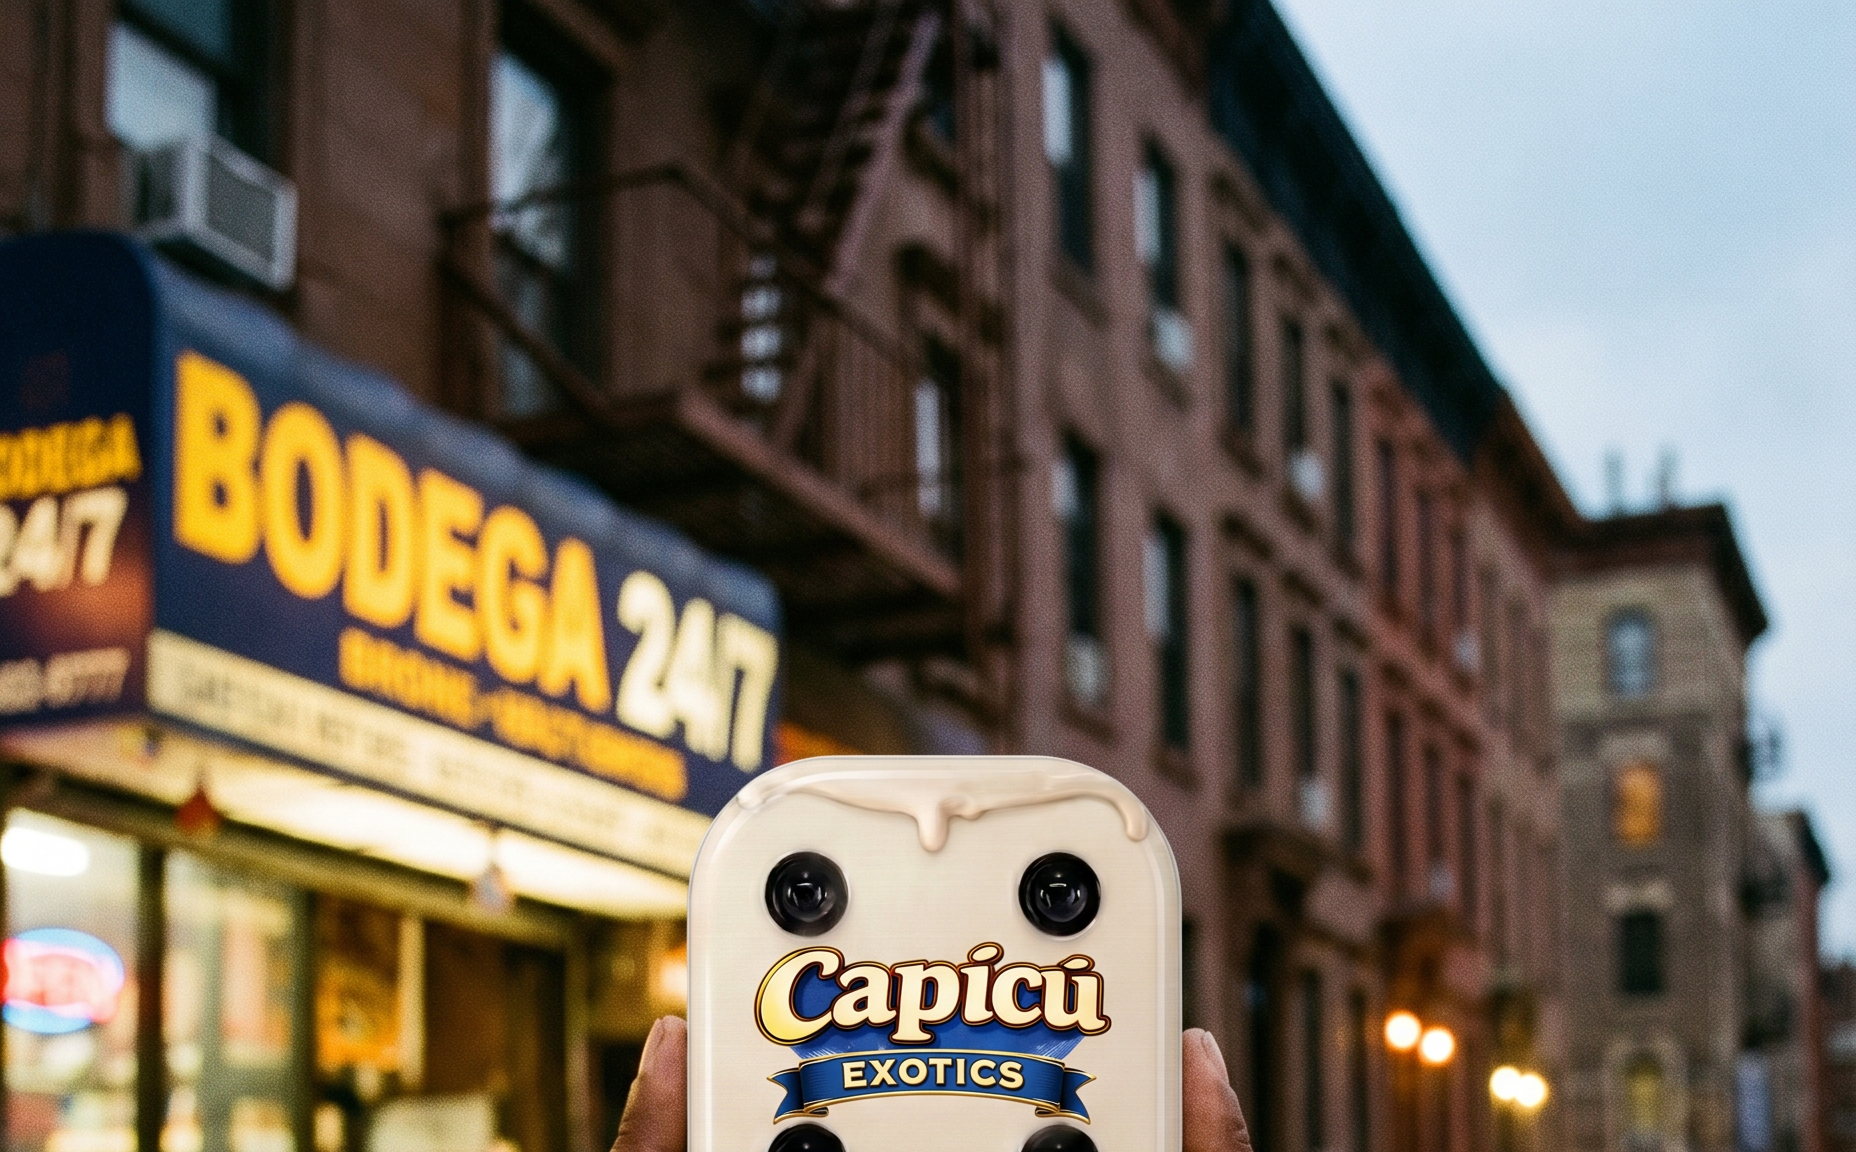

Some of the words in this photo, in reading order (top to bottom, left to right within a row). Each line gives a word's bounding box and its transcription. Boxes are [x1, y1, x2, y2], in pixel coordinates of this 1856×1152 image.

[0, 411, 143, 498] ODEGA
[172, 348, 611, 713] BODEGA
[616, 569, 779, 773] 24/7
[755, 942, 1111, 1044] Capicú
[842, 1057, 1025, 1089] EXOTICS
